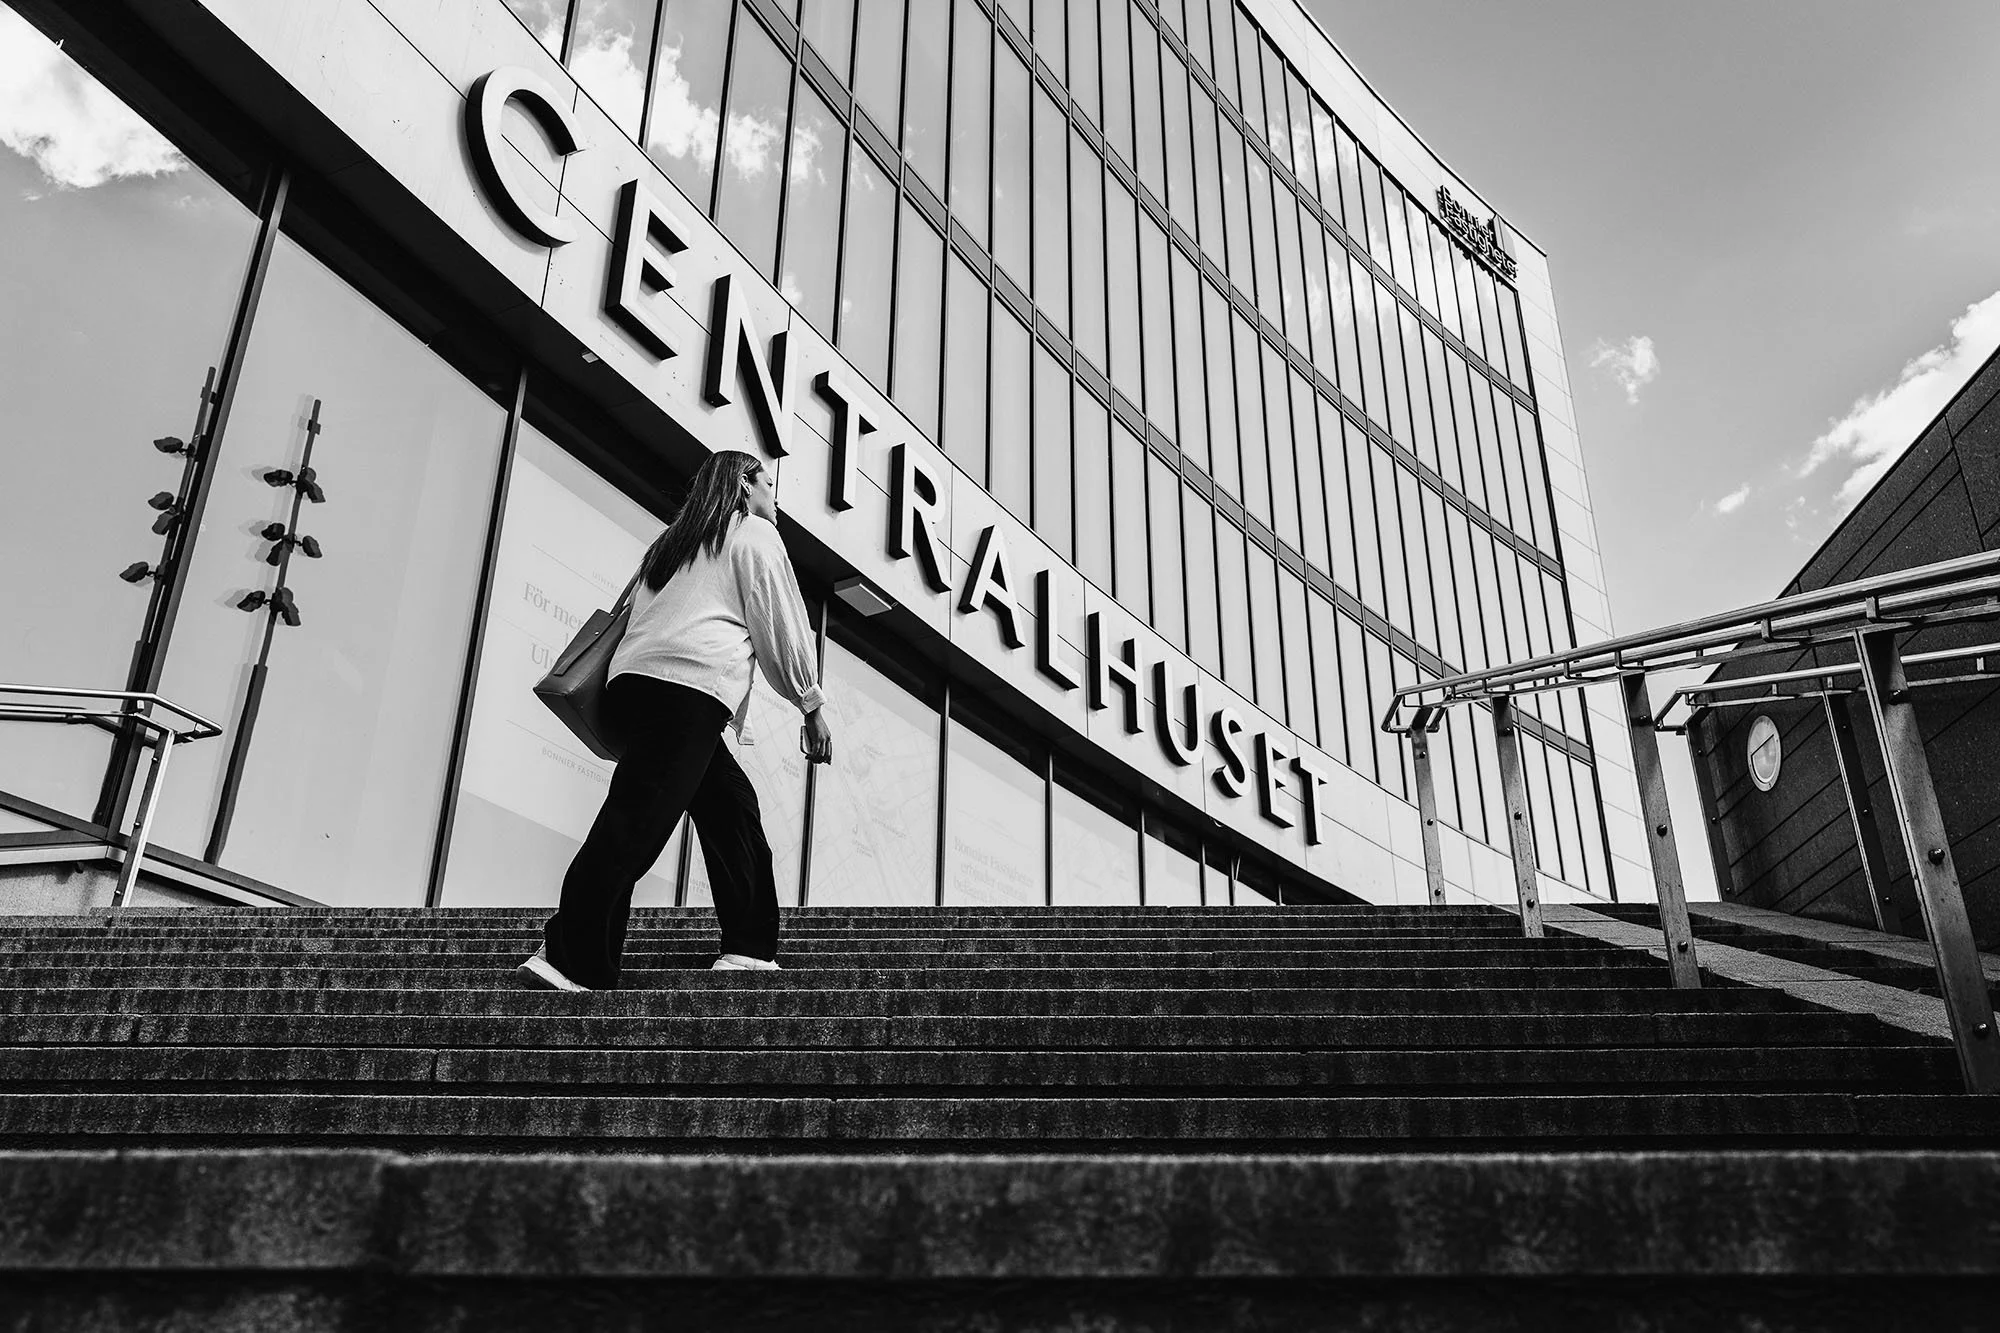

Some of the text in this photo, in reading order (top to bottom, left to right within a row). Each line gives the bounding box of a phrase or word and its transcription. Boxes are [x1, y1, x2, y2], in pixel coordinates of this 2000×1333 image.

[464, 65, 1328, 846] CENTRALHUSET
[522, 582, 551, 613] För
[542, 747, 576, 769] BONNIER
